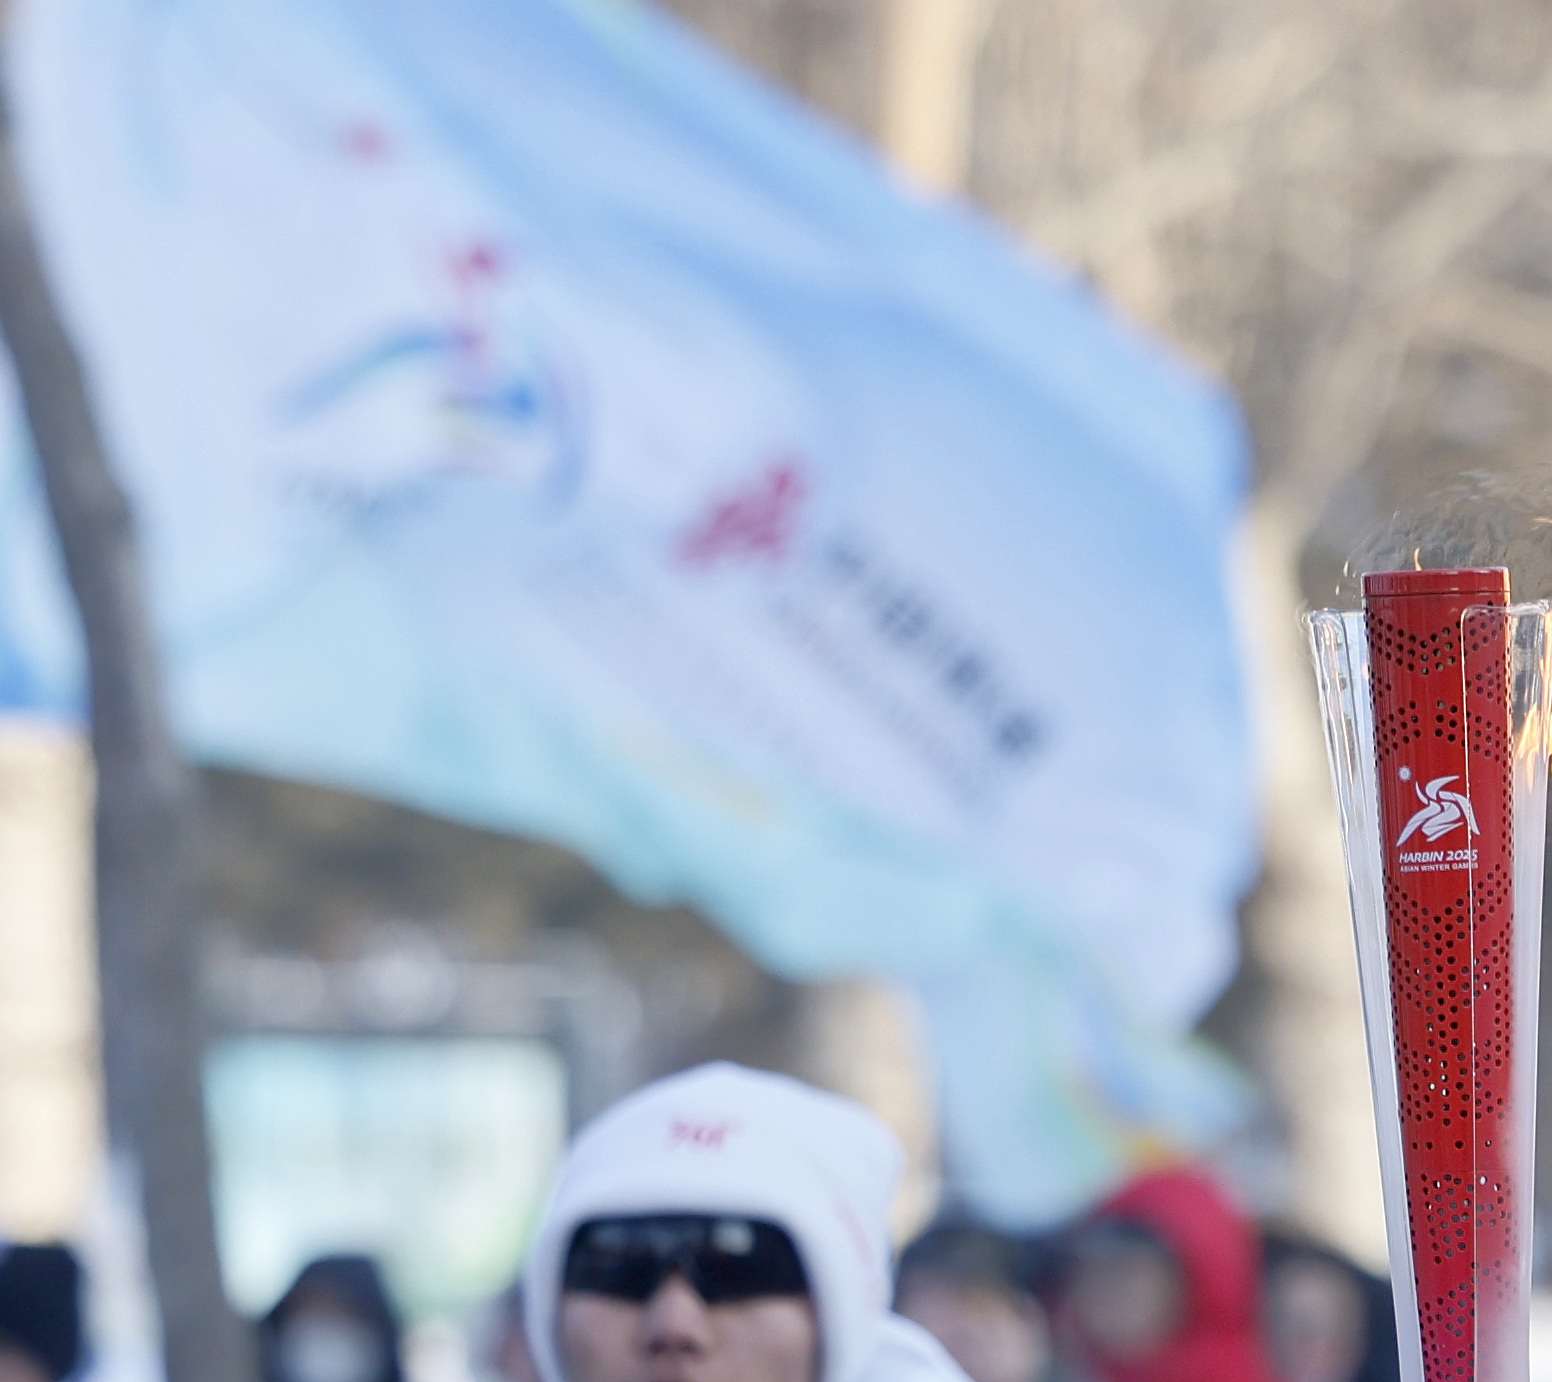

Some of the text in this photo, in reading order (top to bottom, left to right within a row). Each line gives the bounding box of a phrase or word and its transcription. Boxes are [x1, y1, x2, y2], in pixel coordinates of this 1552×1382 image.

[1399, 849, 1478, 863] HARBIN 2025
[1400, 865, 1419, 873] ASIAN
[1421, 863, 1450, 872] WINTER
